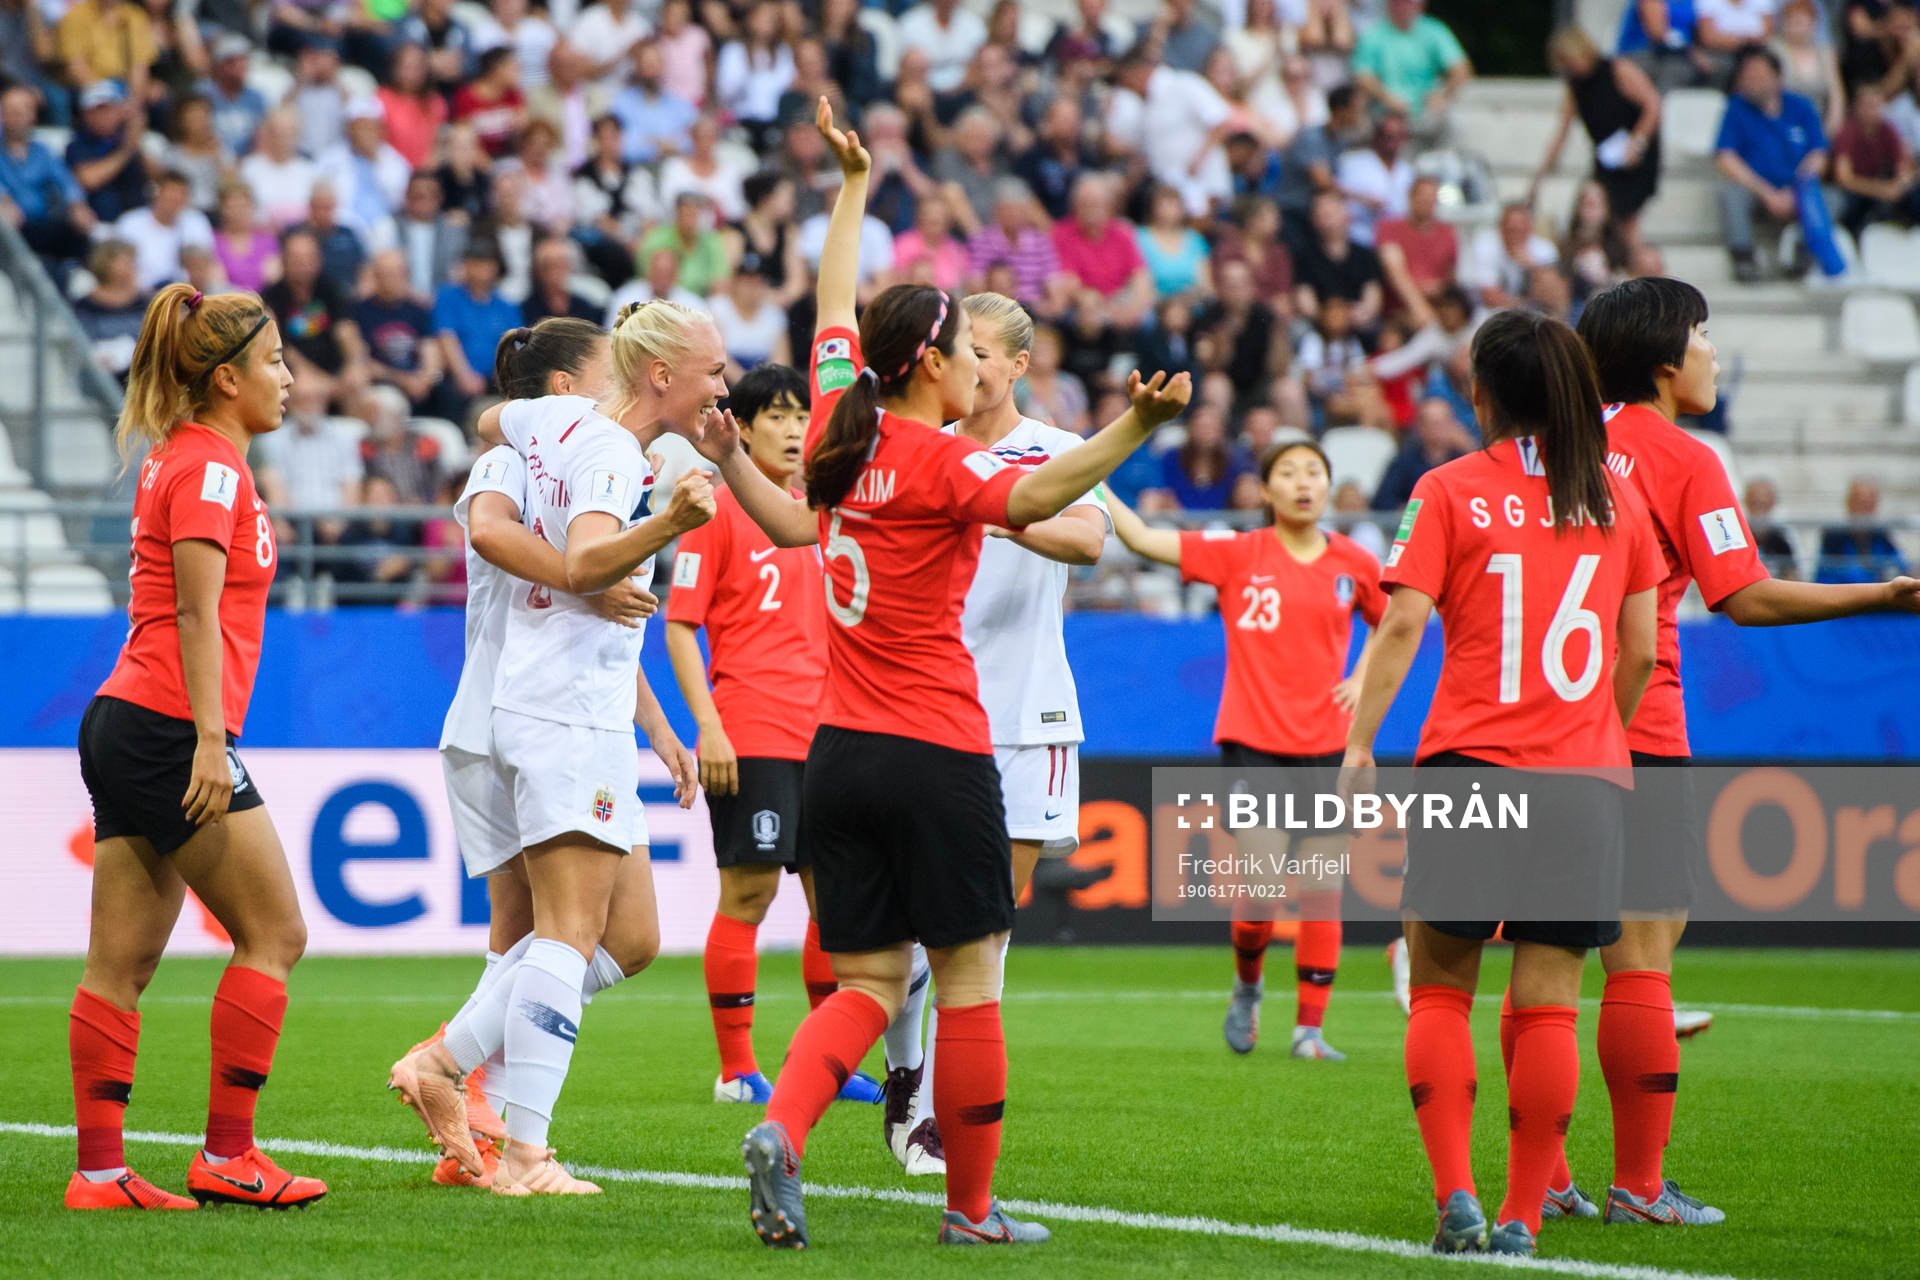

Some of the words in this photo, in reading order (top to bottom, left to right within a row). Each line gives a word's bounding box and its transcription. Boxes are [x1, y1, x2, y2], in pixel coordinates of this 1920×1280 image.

[854, 468, 896, 503] KIM
[255, 513, 274, 569] 8
[824, 506, 872, 628] 5
[758, 563, 782, 612] 2
[1236, 585, 1282, 631] 23
[1485, 553, 1604, 704] 16
[1706, 765, 1920, 913] Or
